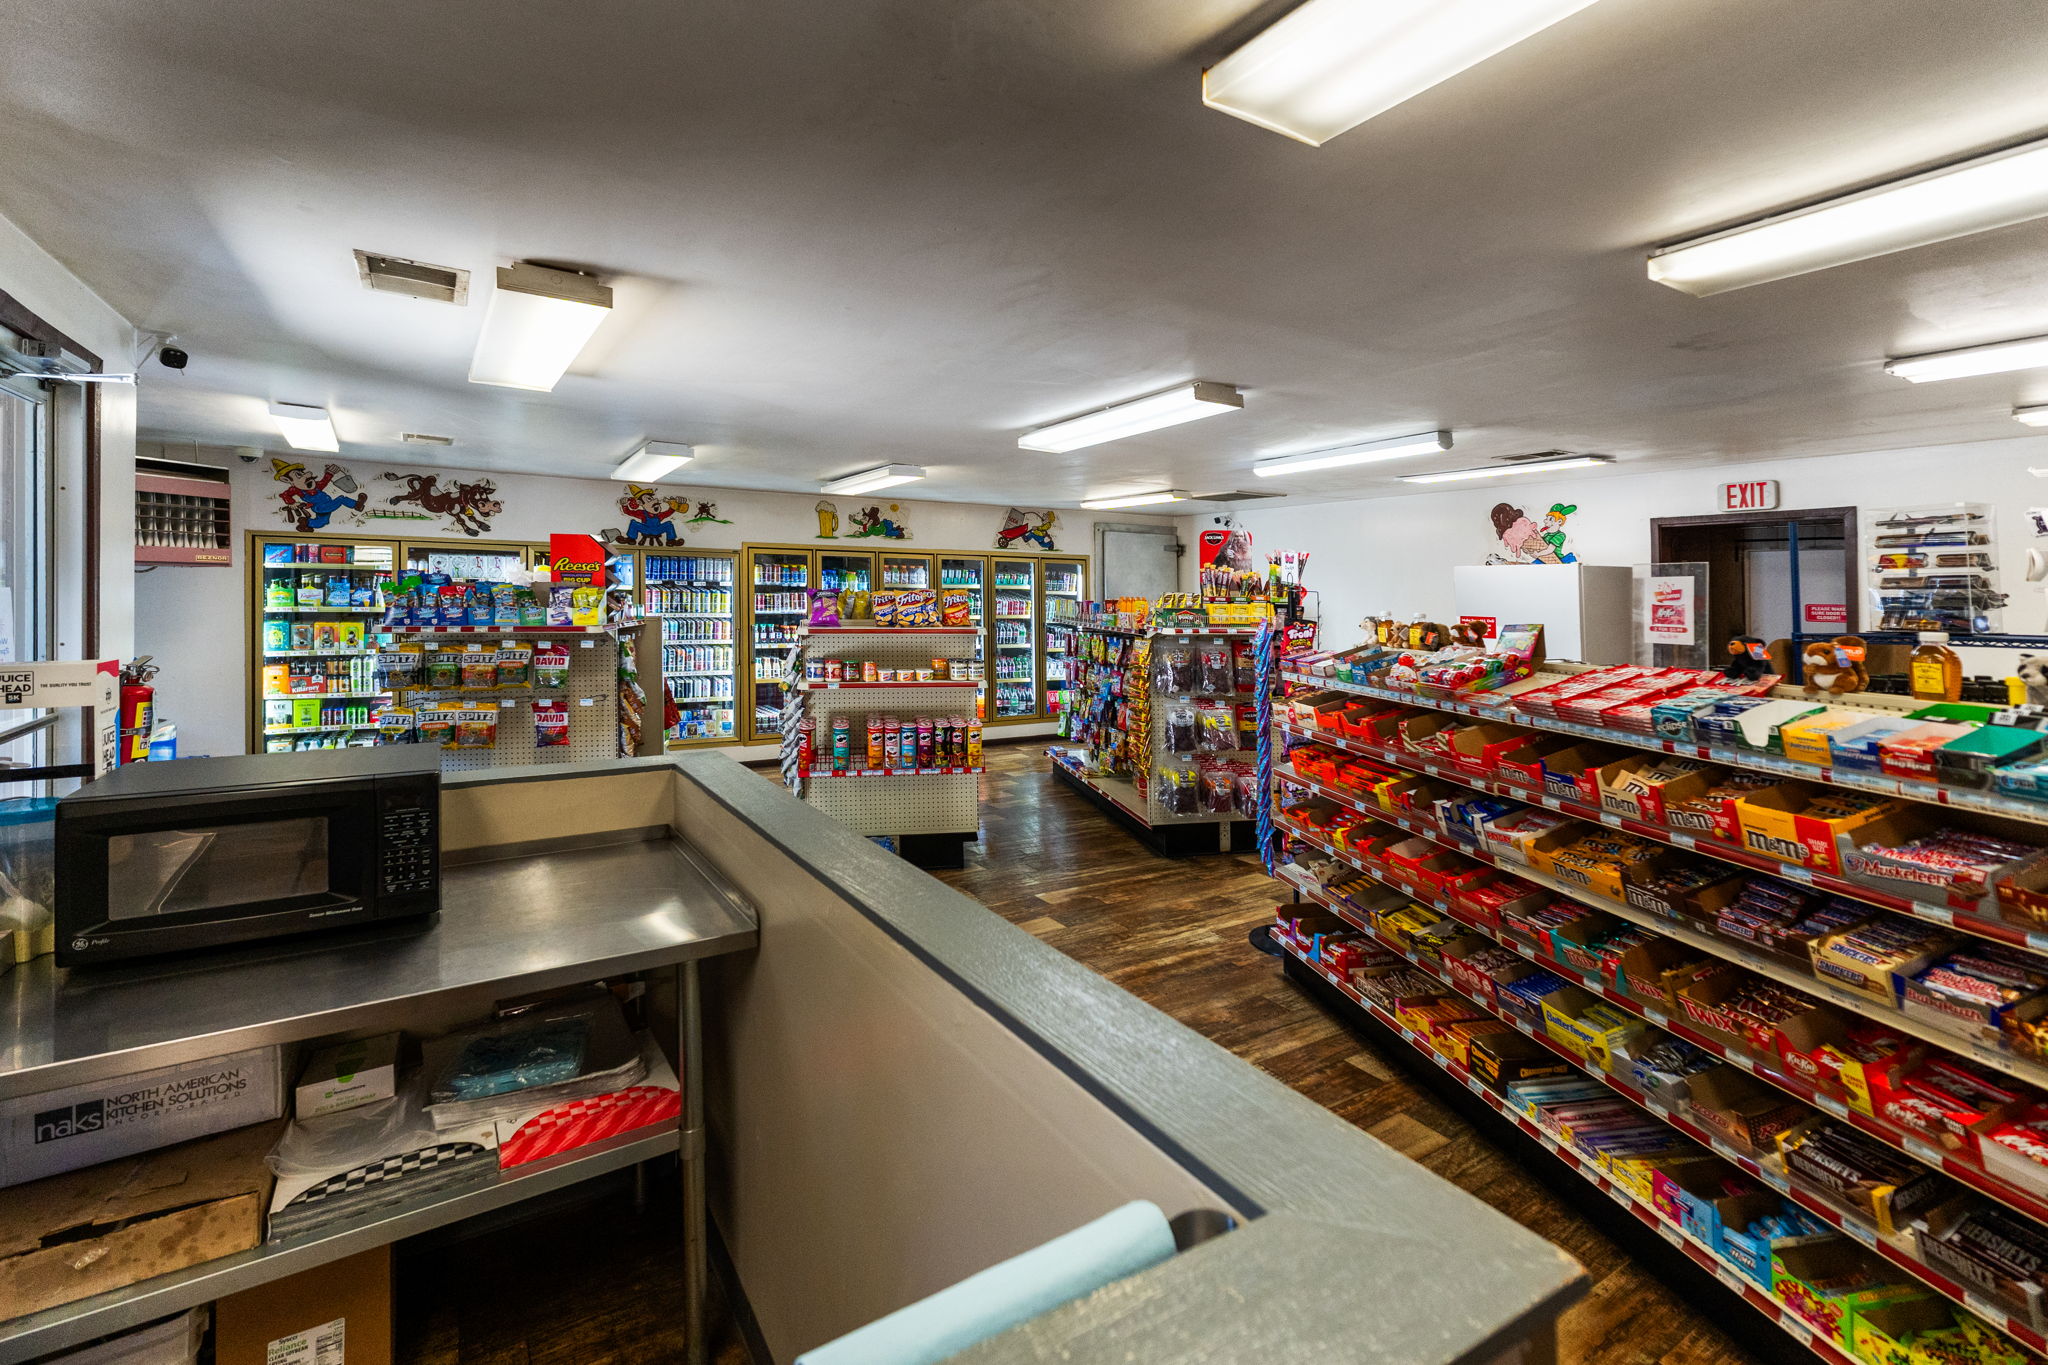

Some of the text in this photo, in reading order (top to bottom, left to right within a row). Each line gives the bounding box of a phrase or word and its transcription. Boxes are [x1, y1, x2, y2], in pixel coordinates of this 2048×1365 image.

[1726, 482, 1767, 509] EXIT
[553, 557, 601, 571] Reese's
[1287, 628, 1314, 640] Trolli
[378, 654, 416, 664] SPITZ
[428, 653, 462, 663] SPITZ
[464, 654, 497, 664] SPITZ
[496, 651, 529, 661] SPITZ
[535, 656, 565, 666] DAVID
[380, 715, 411, 725] SPITZ
[418, 712, 454, 722] SPITZ
[458, 711, 494, 721] SPITZ
[536, 713, 565, 723] DAVID
[1656, 720, 1687, 732] eclipse
[1862, 859, 1951, 887] Musketeers
[1718, 919, 1755, 938] SNICKERS
[1546, 1009, 1594, 1043] Butterfinger
[107, 1068, 240, 1108] NORTH AMERICAN
[106, 1079, 247, 1120] KITCHEN SOLUTIONS
[106, 1092, 241, 1127] INCORPORATED
[37, 1104, 102, 1142] naks
